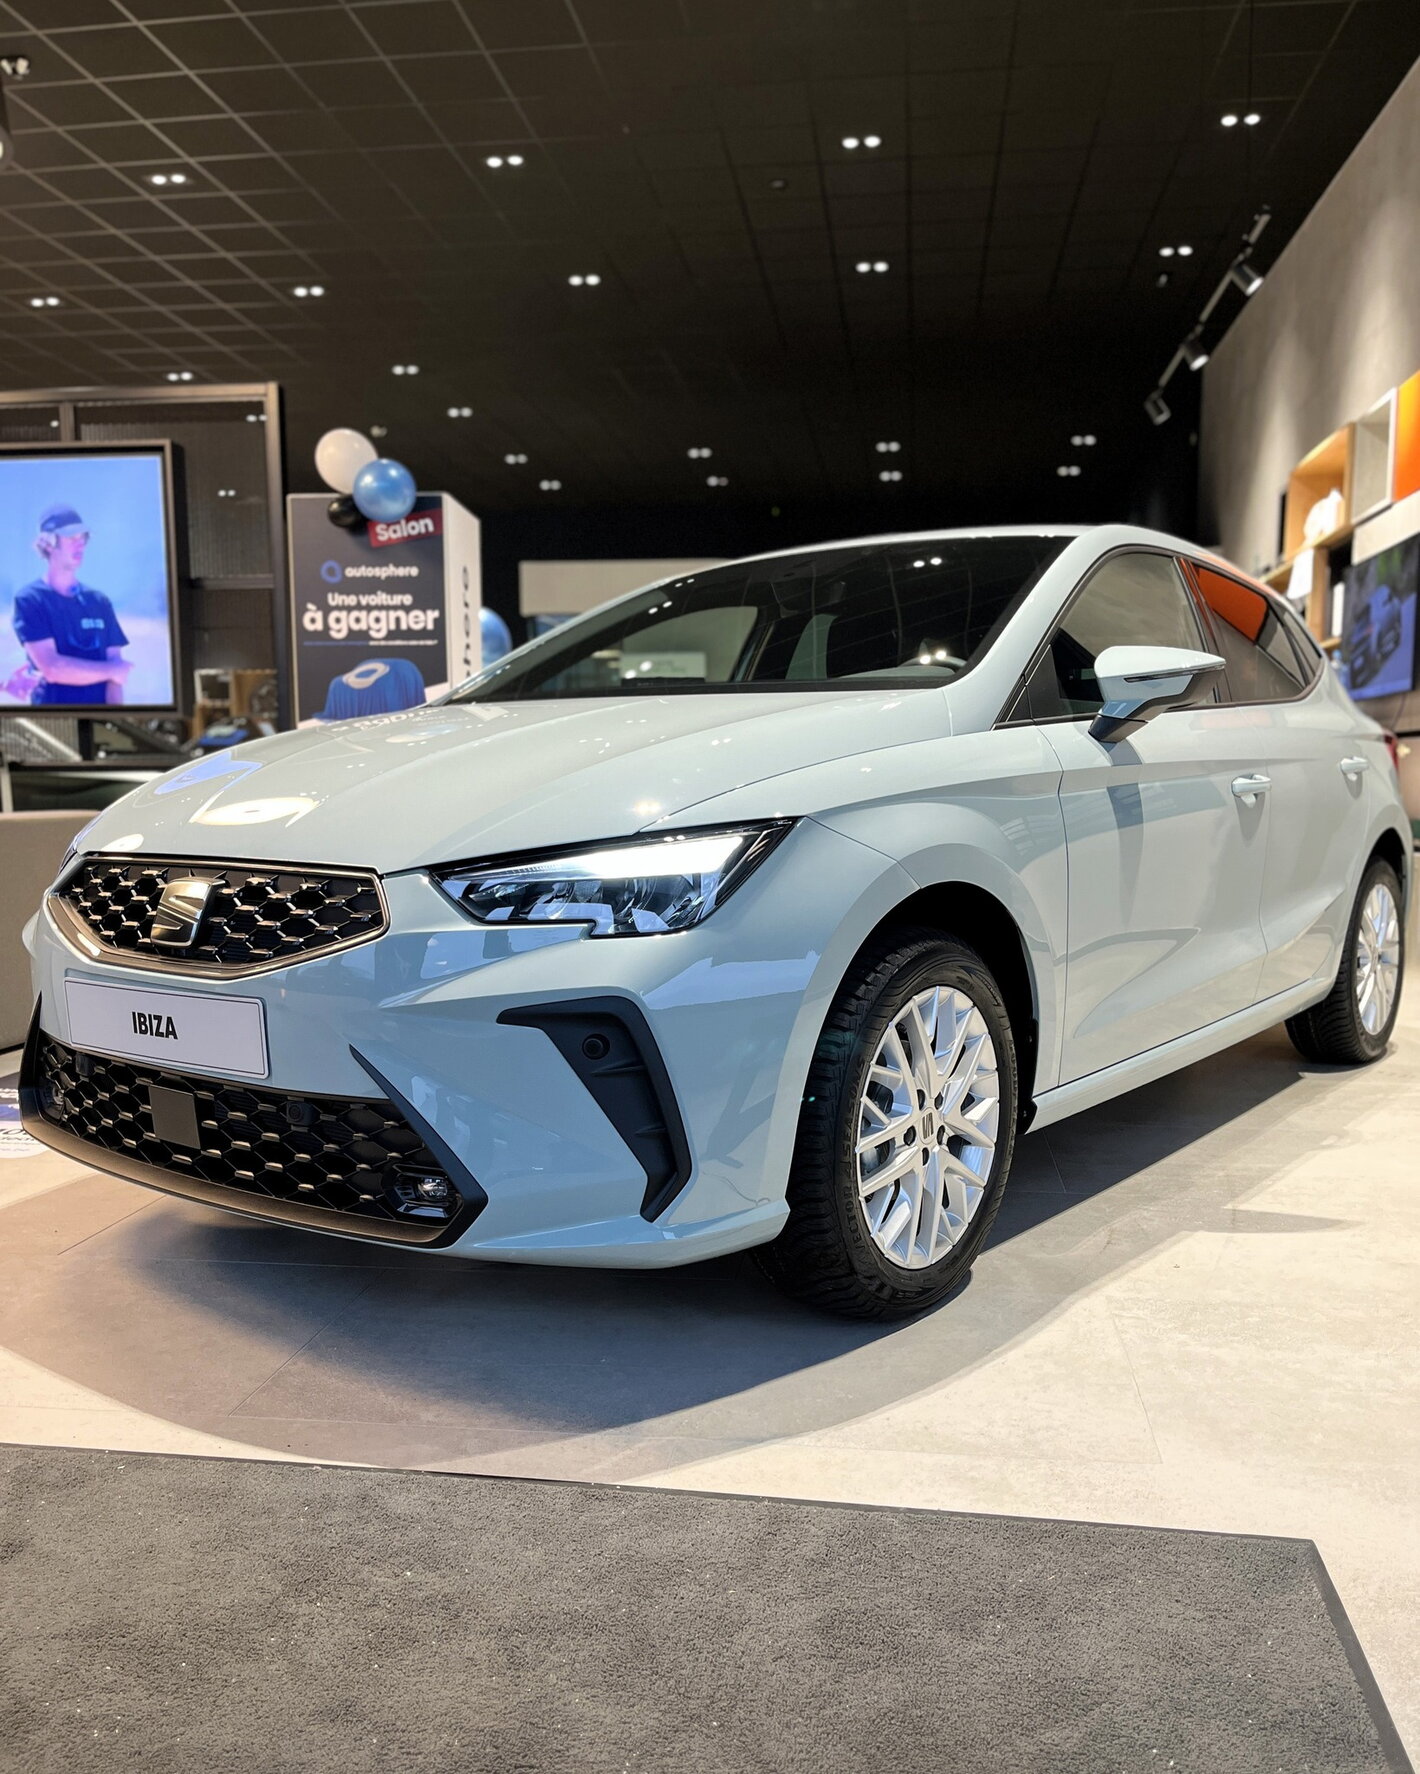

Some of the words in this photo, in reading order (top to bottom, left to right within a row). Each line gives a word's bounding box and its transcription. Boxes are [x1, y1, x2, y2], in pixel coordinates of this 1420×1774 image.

[375, 517, 434, 542] Salon
[345, 564, 419, 580] autosphere
[327, 592, 358, 606] Une
[359, 590, 413, 606] voiture
[302, 603, 323, 631] à
[328, 609, 440, 639] gagner
[131, 1011, 178, 1040] IBIZA
